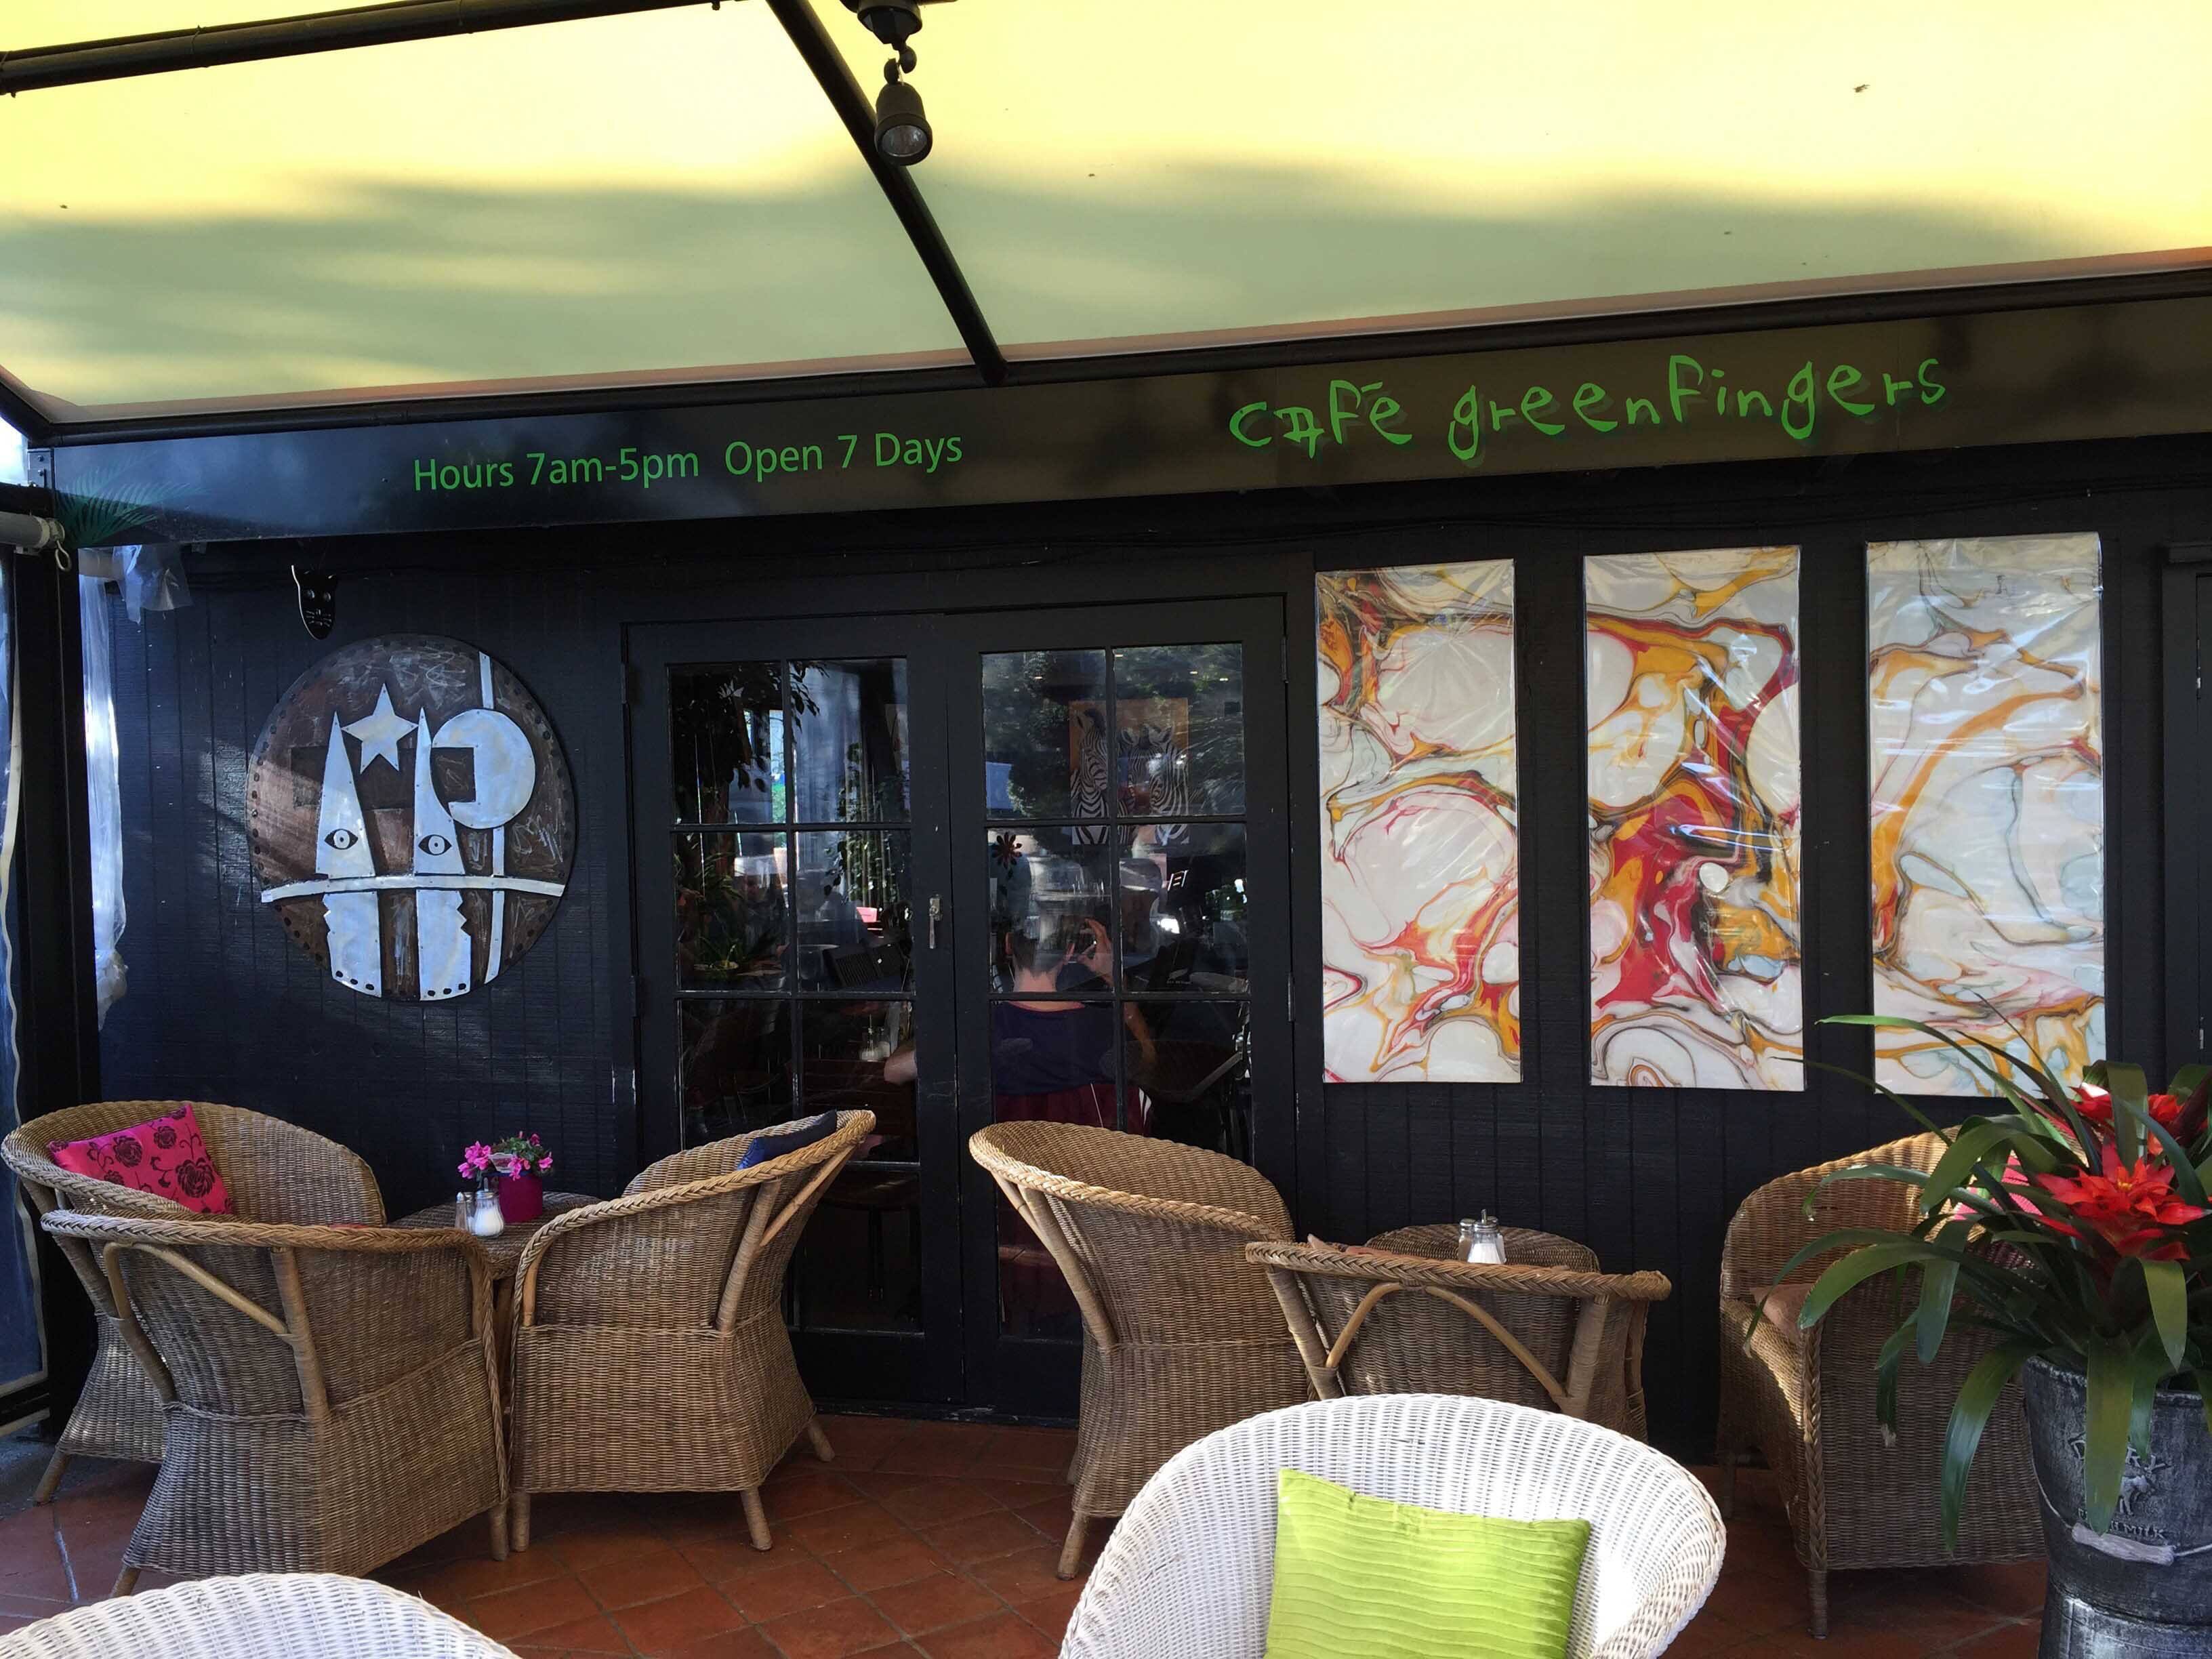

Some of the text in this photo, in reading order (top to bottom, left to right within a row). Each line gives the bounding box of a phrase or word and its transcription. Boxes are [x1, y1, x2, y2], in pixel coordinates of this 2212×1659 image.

[413, 432, 964, 491] Hours 7am-5pm Open 7 Days
